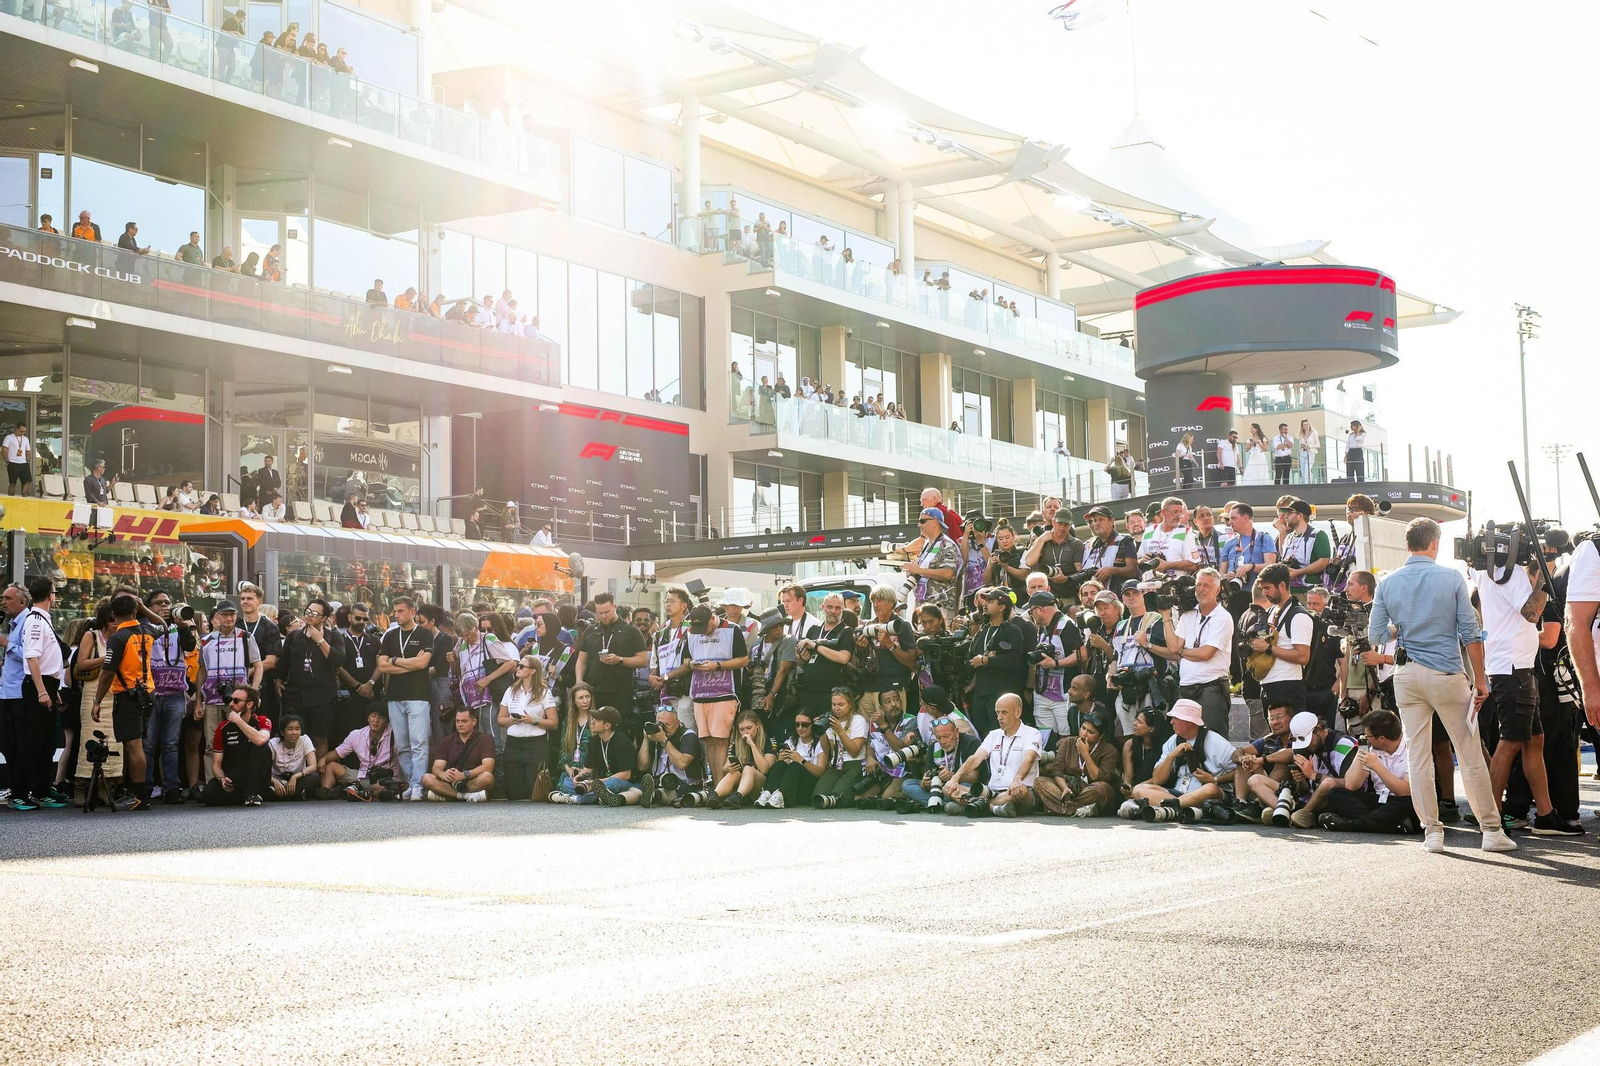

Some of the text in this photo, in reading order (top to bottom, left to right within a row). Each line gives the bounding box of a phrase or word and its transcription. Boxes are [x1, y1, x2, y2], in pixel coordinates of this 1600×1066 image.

[0, 246, 142, 284] PADDOCK CLUB
[344, 311, 405, 344] Abu Dhabi
